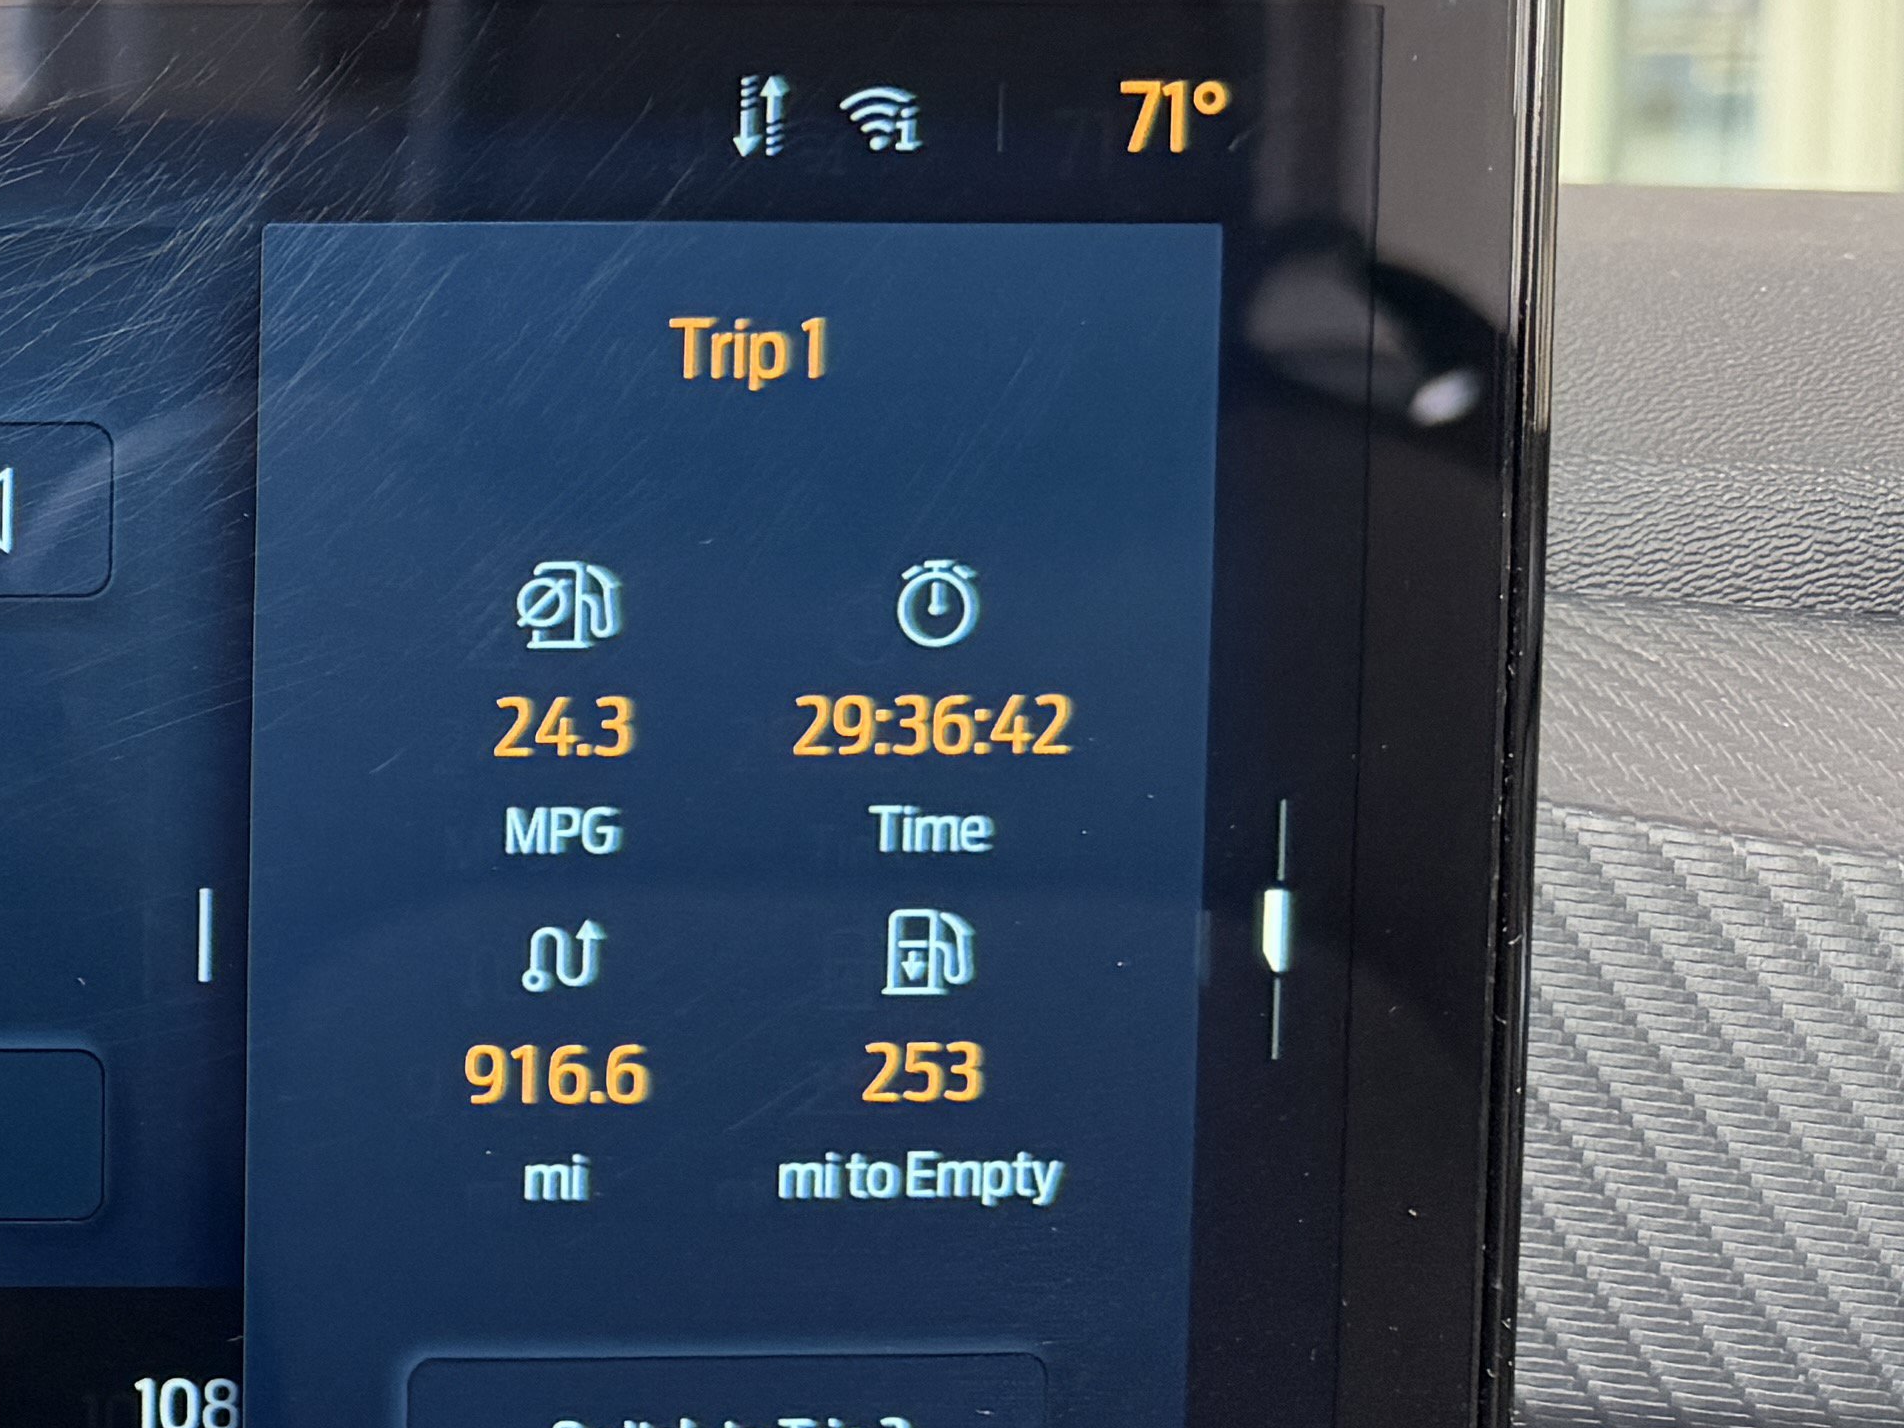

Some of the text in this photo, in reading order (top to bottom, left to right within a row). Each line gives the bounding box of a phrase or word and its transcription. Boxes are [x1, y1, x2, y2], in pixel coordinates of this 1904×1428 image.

[1121, 81, 1227, 152] 71°
[669, 318, 822, 390] Trip 1
[494, 696, 630, 756] 24.3
[794, 694, 1070, 755] 29:36:42
[506, 807, 619, 854] MPG
[869, 805, 992, 852] Time
[465, 1044, 646, 1104] 916.6
[863, 1042, 980, 1101] 253
[525, 1154, 586, 1200] mi
[779, 1151, 1063, 1206] mi to Empty
